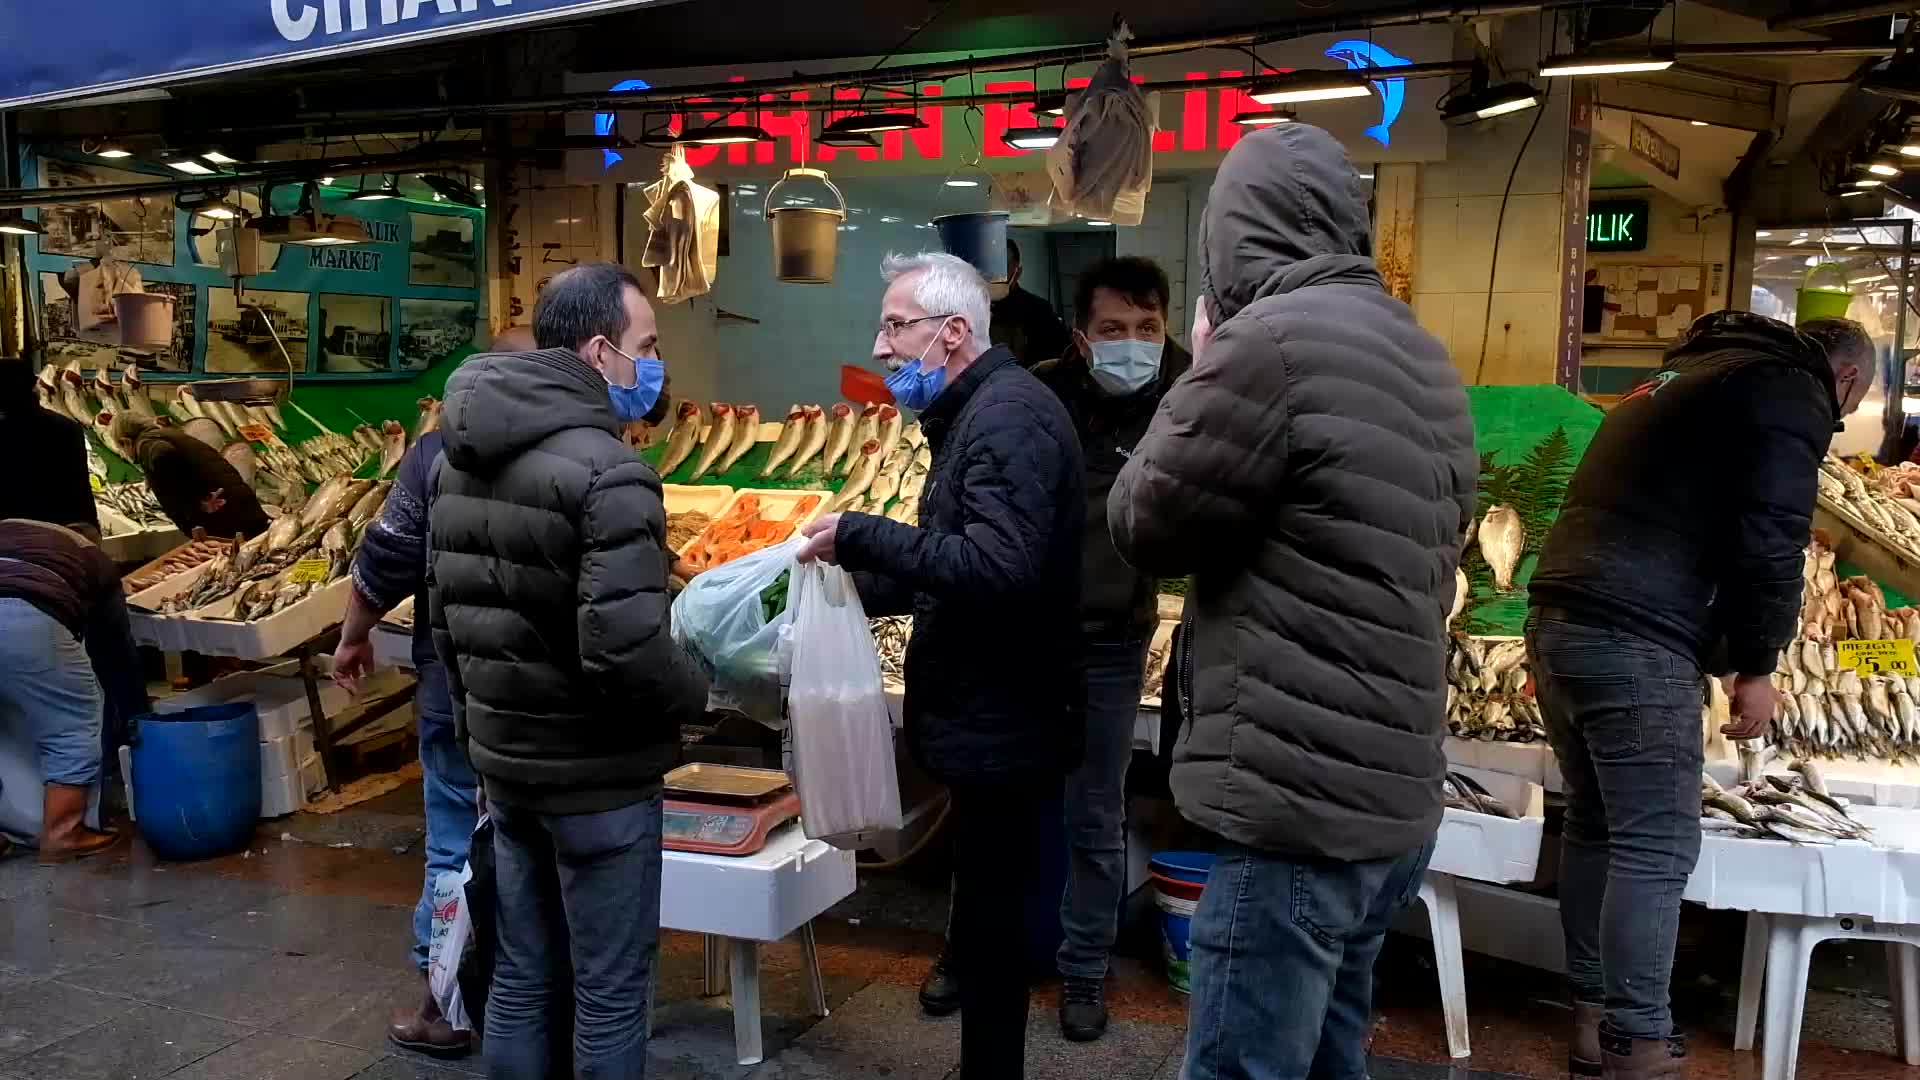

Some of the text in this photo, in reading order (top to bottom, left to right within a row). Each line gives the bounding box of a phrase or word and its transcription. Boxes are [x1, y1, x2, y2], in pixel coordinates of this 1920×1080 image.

[983, 67, 1297, 157] BIK
[360, 219, 401, 243] ALIK
[1584, 213, 1634, 242] ILIK
[308, 247, 382, 273] MARKET
